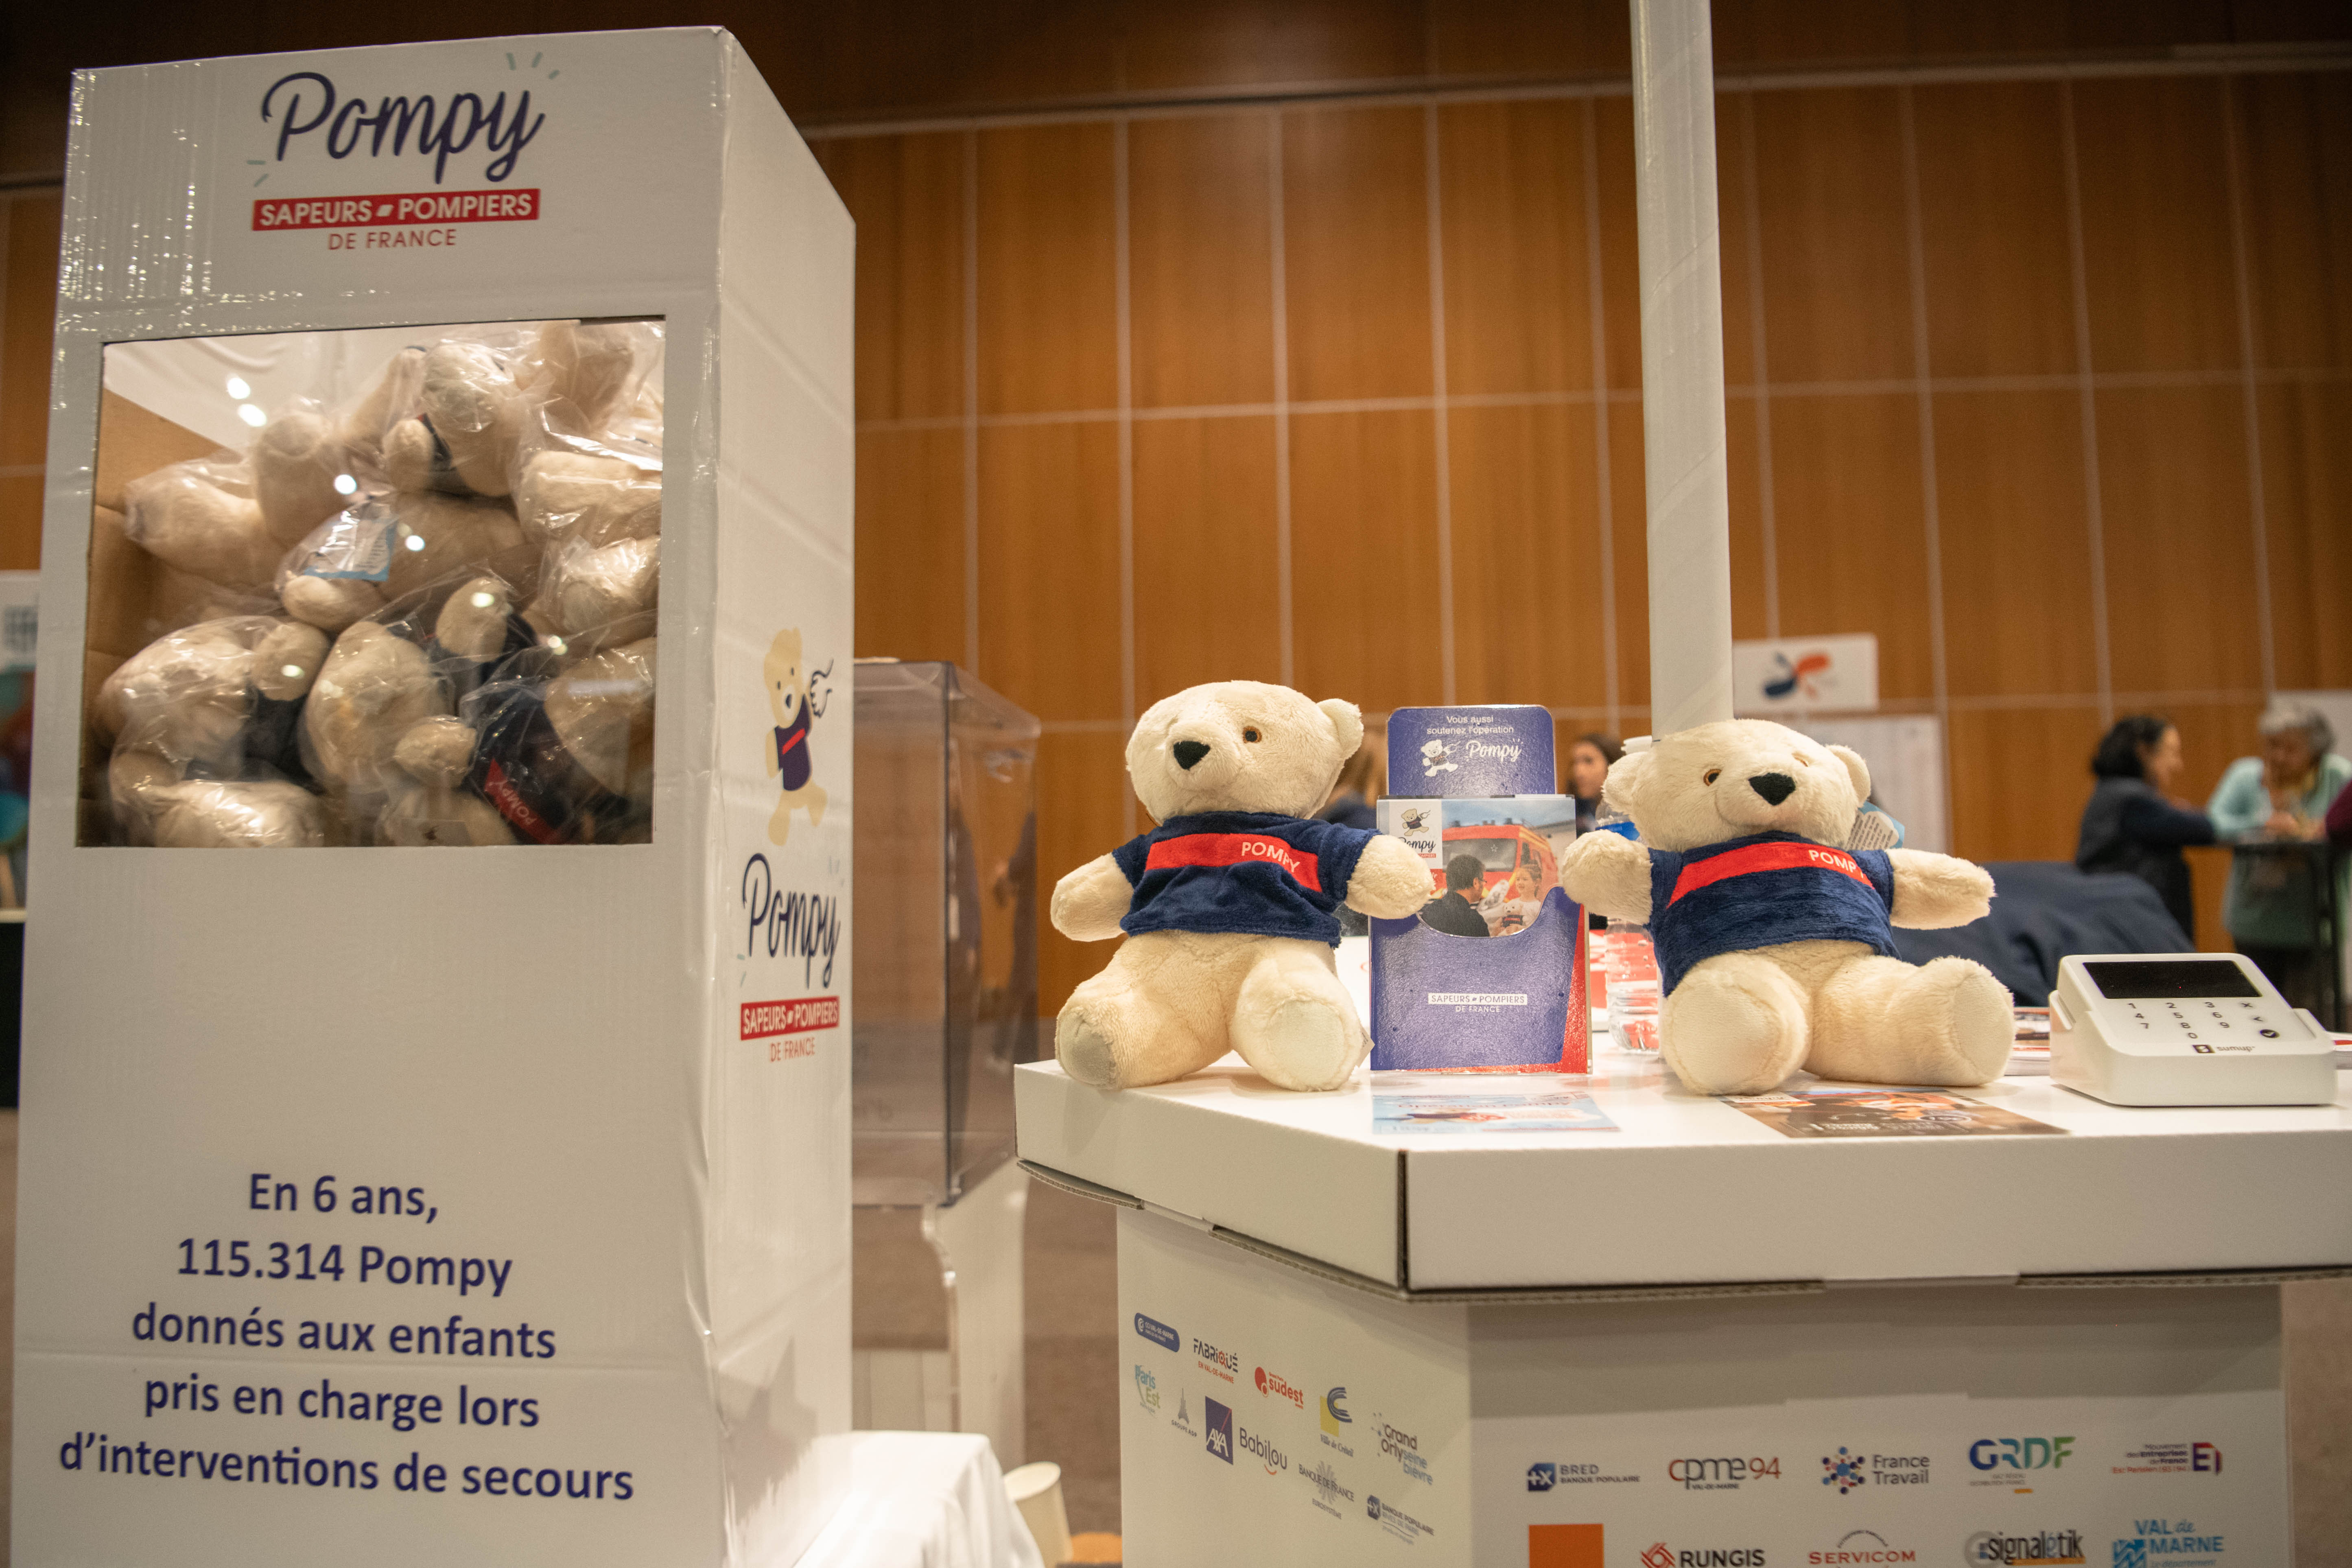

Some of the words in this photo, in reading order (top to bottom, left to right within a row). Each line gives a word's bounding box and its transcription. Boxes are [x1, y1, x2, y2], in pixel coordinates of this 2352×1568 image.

[262, 72, 546, 184] Pompy
[259, 200, 373, 226] SAPEURS
[398, 194, 532, 221] POMPIERS
[328, 233, 356, 250] DE
[366, 229, 457, 248] FRANCE
[1466, 740, 1522, 762] Pompy
[1241, 842, 1300, 873] POMPY
[1808, 849, 1865, 878] POMP
[742, 853, 841, 990] Pompy
[743, 1004, 787, 1035] SAPEURS
[793, 1001, 838, 1028] POMPIERS
[769, 1042, 781, 1063] DE
[785, 1037, 815, 1059] FRANCE
[249, 1173, 297, 1211] En
[313, 1176, 337, 1213] 6
[351, 1185, 438, 1223] ans,
[178, 1238, 344, 1282] 115.314
[359, 1245, 513, 1297] Pompy
[133, 1301, 284, 1347] donnés
[298, 1321, 375, 1352] aux
[389, 1315, 556, 1358] enfants
[1198, 1361, 1204, 1369] EN
[1204, 1364, 1234, 1384] VAL-DE-MARNE
[145, 1372, 220, 1417] pris
[234, 1385, 283, 1415] en
[299, 1379, 443, 1432] charge
[459, 1385, 540, 1427] lors
[1146, 1386, 1161, 1408] Est
[1268, 1378, 1303, 1405] sudest
[1206, 1428, 1229, 1457] AXA
[1239, 1427, 1287, 1470] Babilou
[1384, 1424, 1417, 1451] Grand
[60, 1431, 379, 1490] d’interventions
[393, 1452, 447, 1493] de
[462, 1465, 634, 1500] secours
[1381, 1439, 1404, 1463] Orly
[1403, 1449, 1428, 1470] seine
[1873, 1454, 1930, 1468] France
[1969, 1436, 2076, 1471] GRDF
[1298, 1463, 1322, 1485] BANQUE
[1331, 1480, 1355, 1502] FRANCE
[1560, 1464, 1599, 1475] BRED
[1596, 1475, 1641, 1483] POPULAIRE
[1873, 1470, 1929, 1485] Travail
[2135, 1519, 2173, 1535] VAL
[1680, 1549, 1766, 1568] RUNGIS
[1808, 1550, 1916, 1565] SERVICOM
[2149, 1536, 2224, 1553] MARNE
